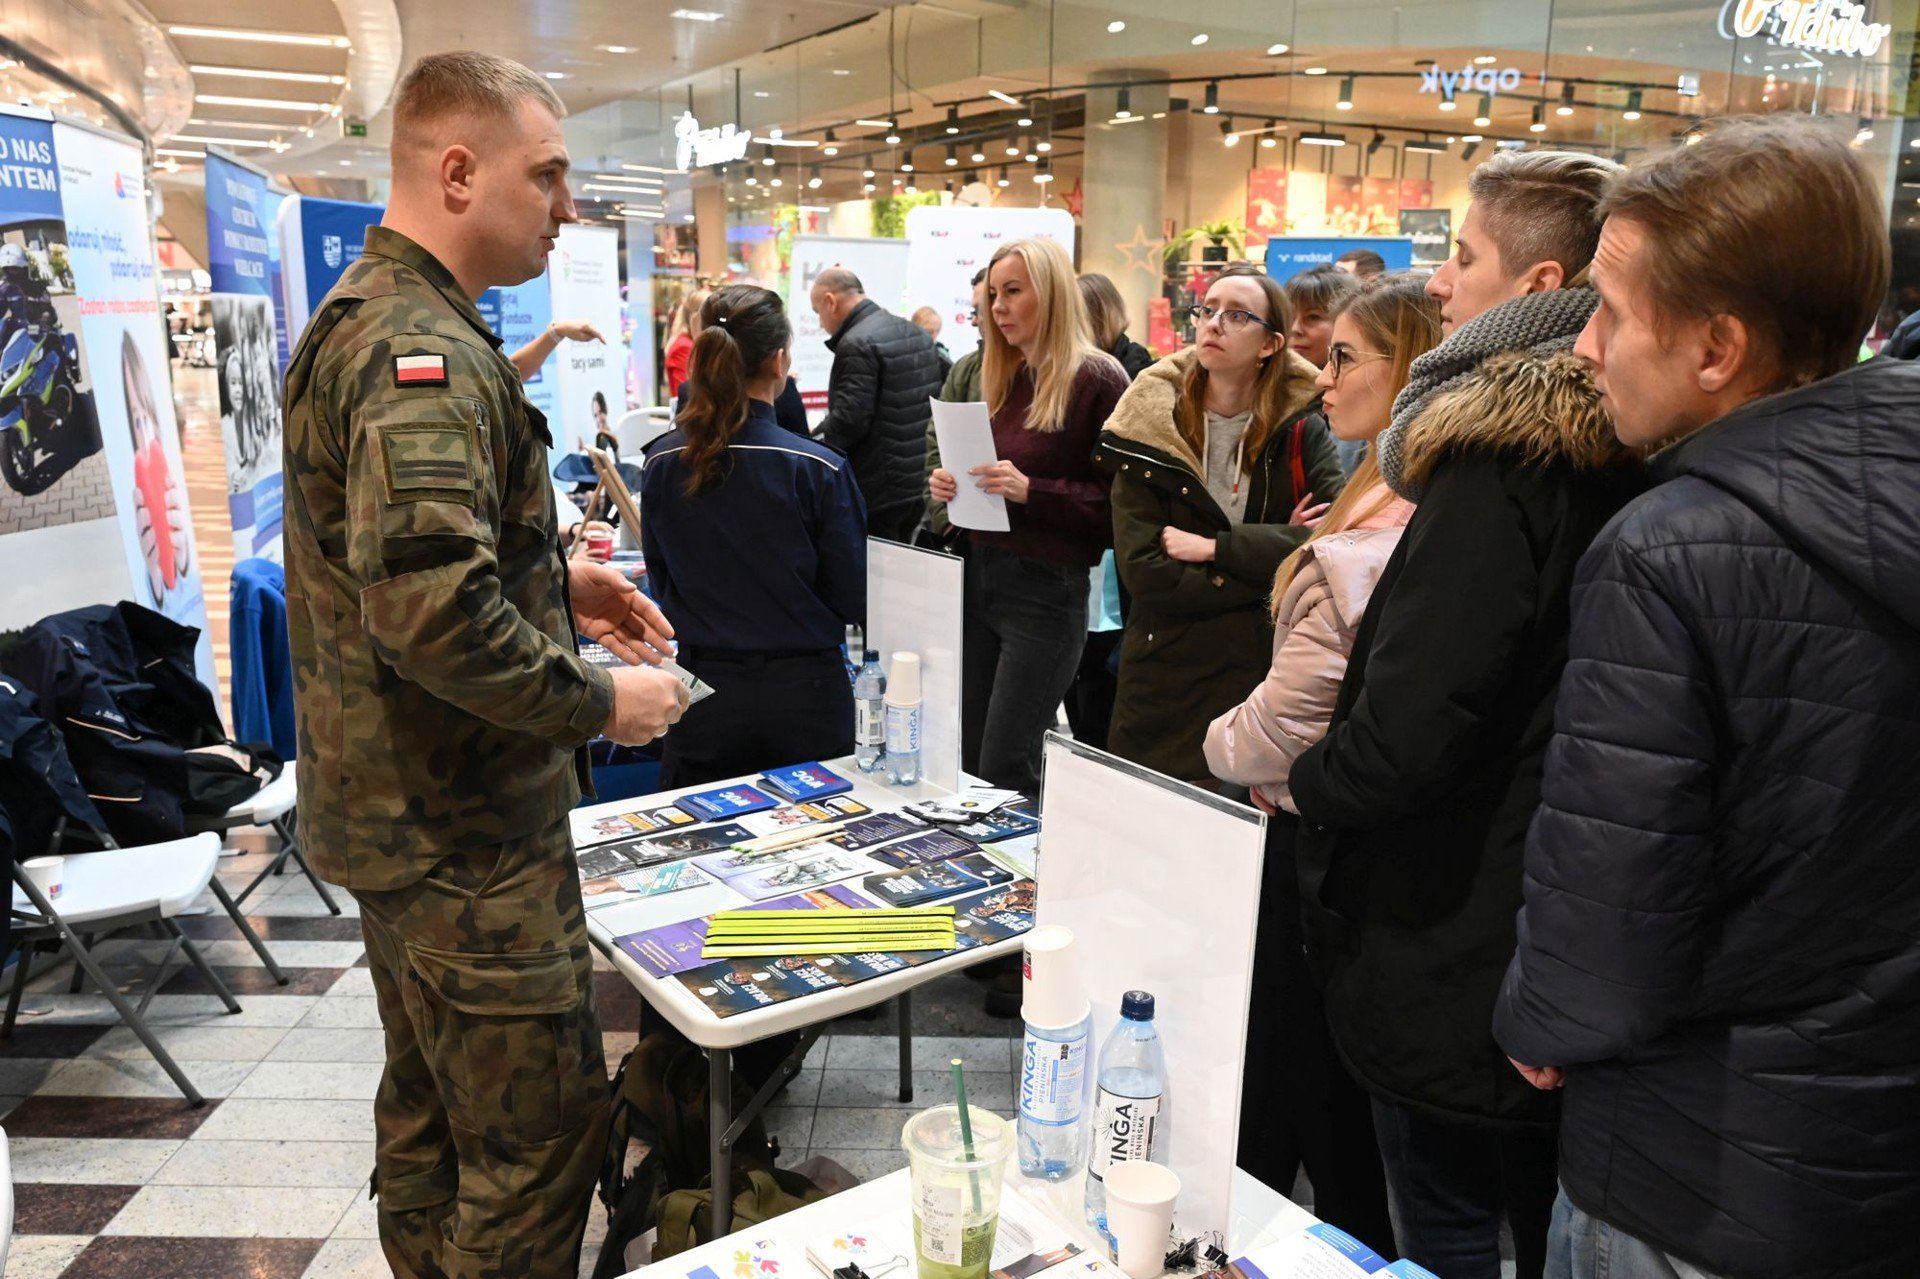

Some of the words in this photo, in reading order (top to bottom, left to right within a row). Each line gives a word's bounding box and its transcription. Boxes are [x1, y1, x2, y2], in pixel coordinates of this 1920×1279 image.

[11, 138, 52, 165] NAS
[1293, 252, 1332, 262] randstad
[910, 709, 921, 750] KINGA
[1021, 1040, 1037, 1111] KINGA
[1111, 1103, 1133, 1166] INGA
